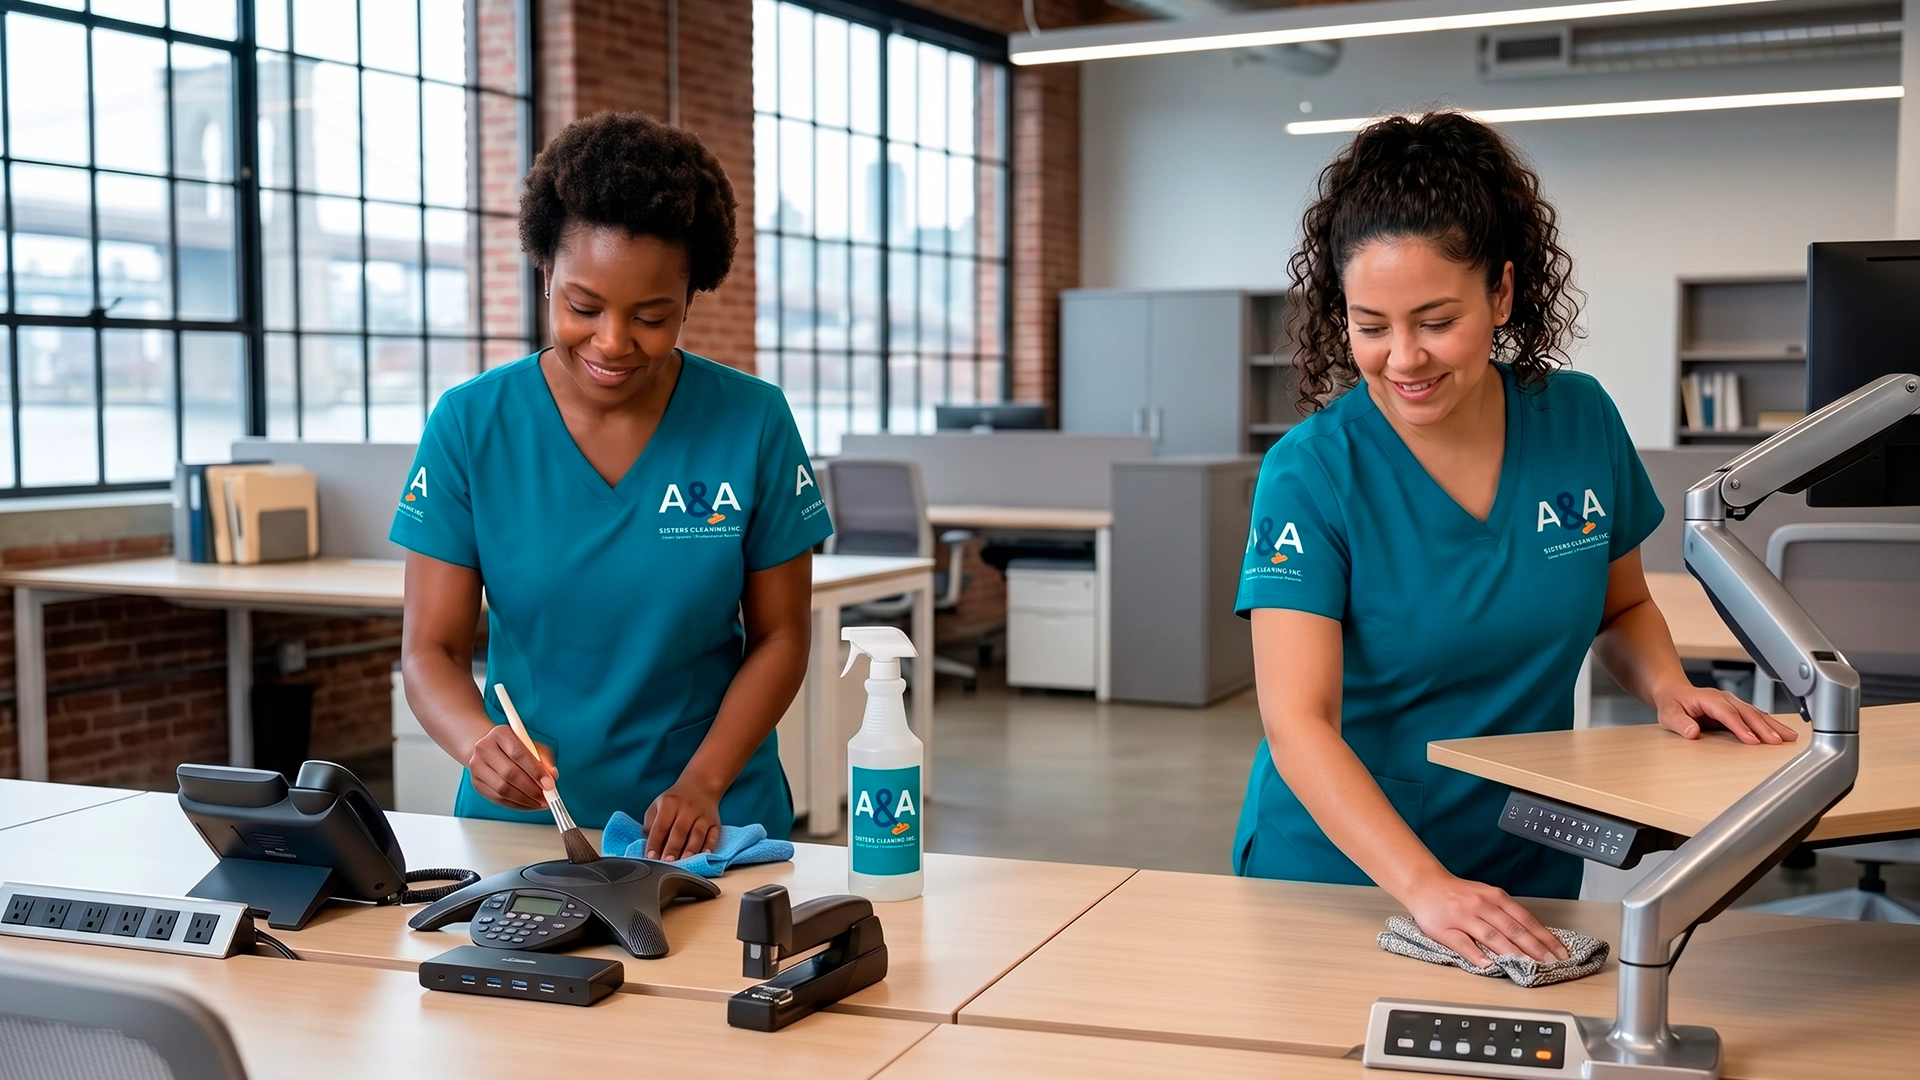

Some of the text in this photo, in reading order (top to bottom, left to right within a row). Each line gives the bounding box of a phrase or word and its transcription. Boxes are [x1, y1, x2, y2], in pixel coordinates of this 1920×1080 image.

[658, 481, 742, 518] A&A
[1537, 488, 1607, 532] A&A
[689, 526, 727, 534] CLEANING
[1246, 516, 1304, 557] &A
[855, 788, 916, 828] A&A
